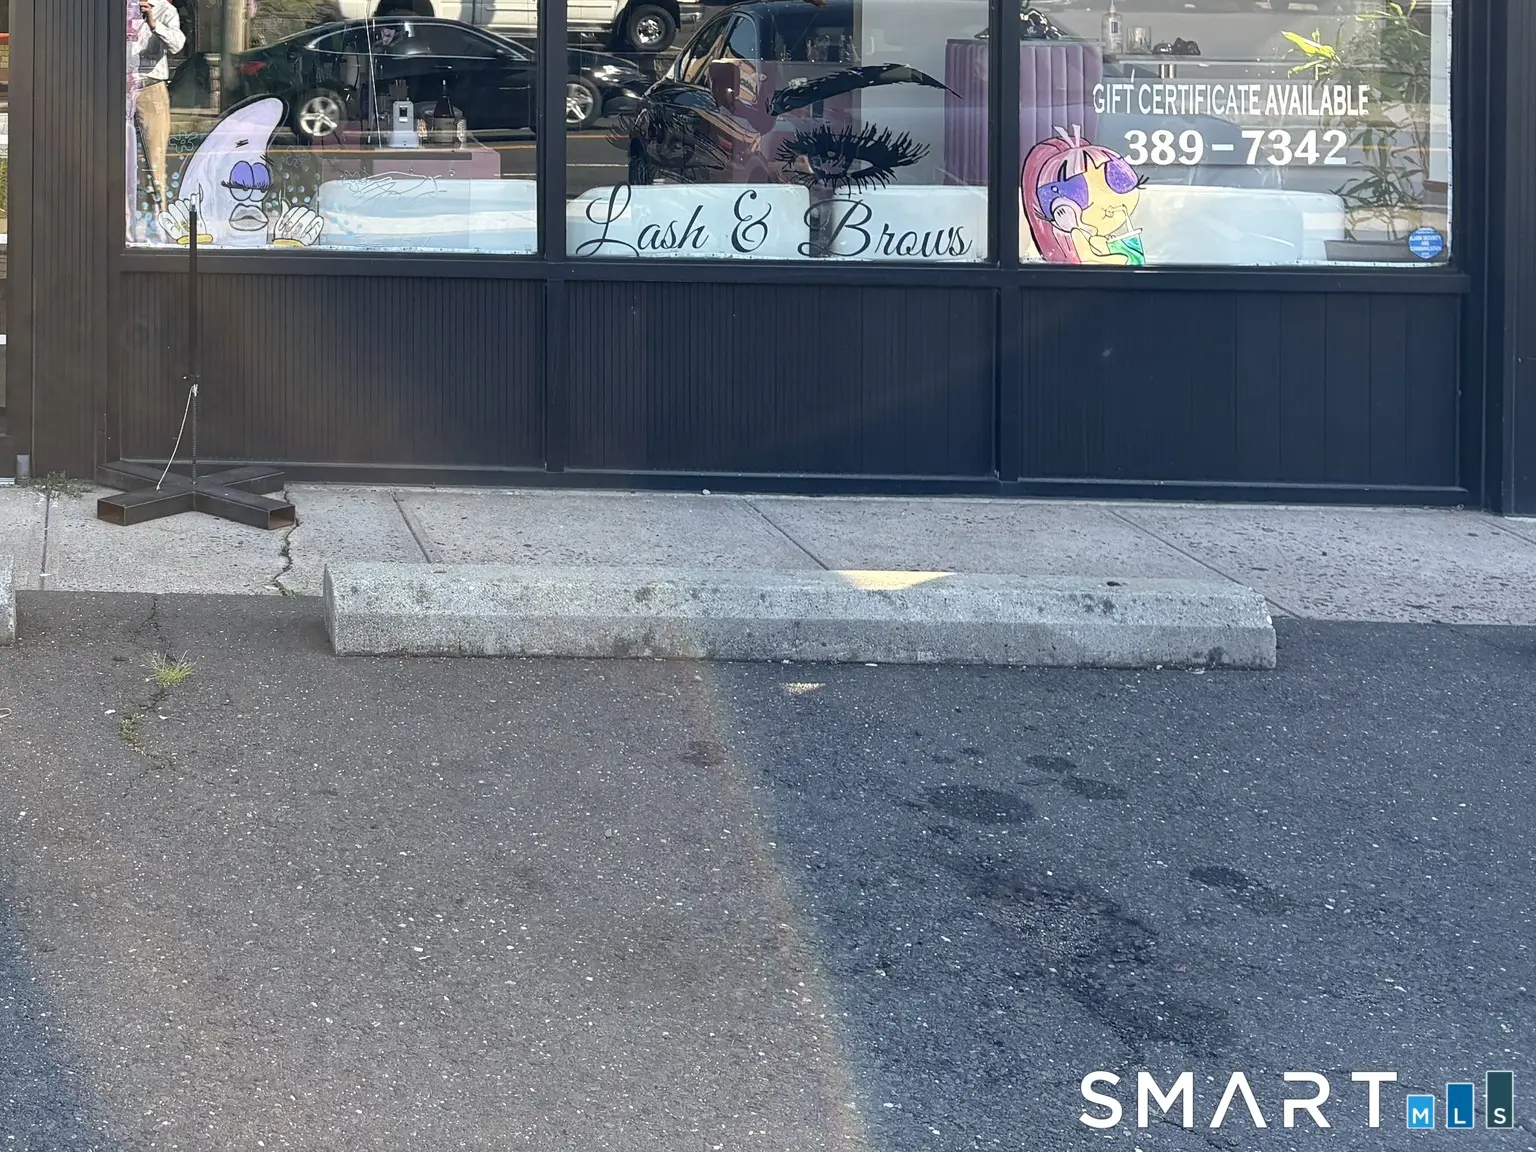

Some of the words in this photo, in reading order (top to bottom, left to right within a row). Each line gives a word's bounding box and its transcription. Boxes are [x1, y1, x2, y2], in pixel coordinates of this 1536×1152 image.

[1092, 83, 1135, 115] GIFT
[1137, 83, 1261, 116] CERTIFICATE
[1264, 83, 1370, 116] AVAILABLE
[575, 181, 710, 258] Lash
[731, 189, 773, 254] &
[797, 198, 975, 259] Brows
